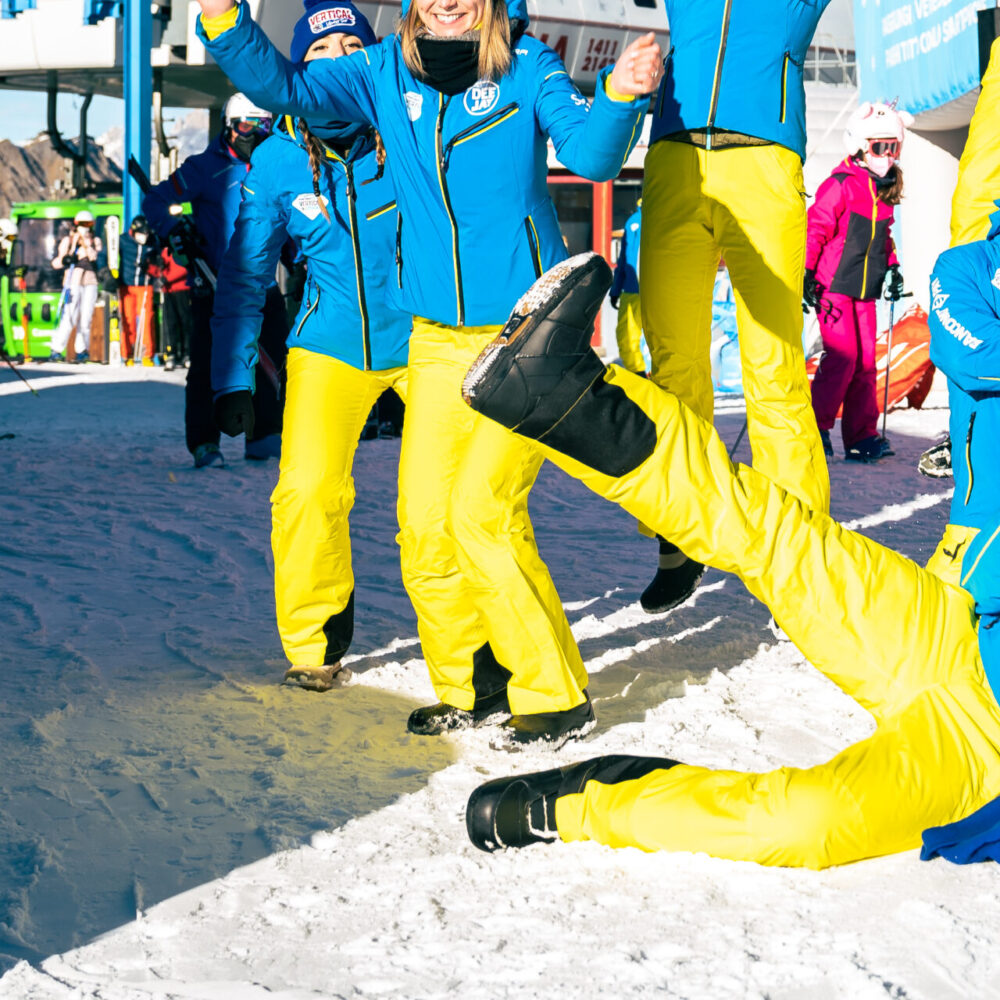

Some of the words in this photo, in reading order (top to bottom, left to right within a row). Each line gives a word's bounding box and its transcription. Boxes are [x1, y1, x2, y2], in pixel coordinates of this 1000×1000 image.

[309, 9, 353, 26] VERTICAL
[587, 37, 619, 56] 1411
[471, 86, 496, 101] DEE
